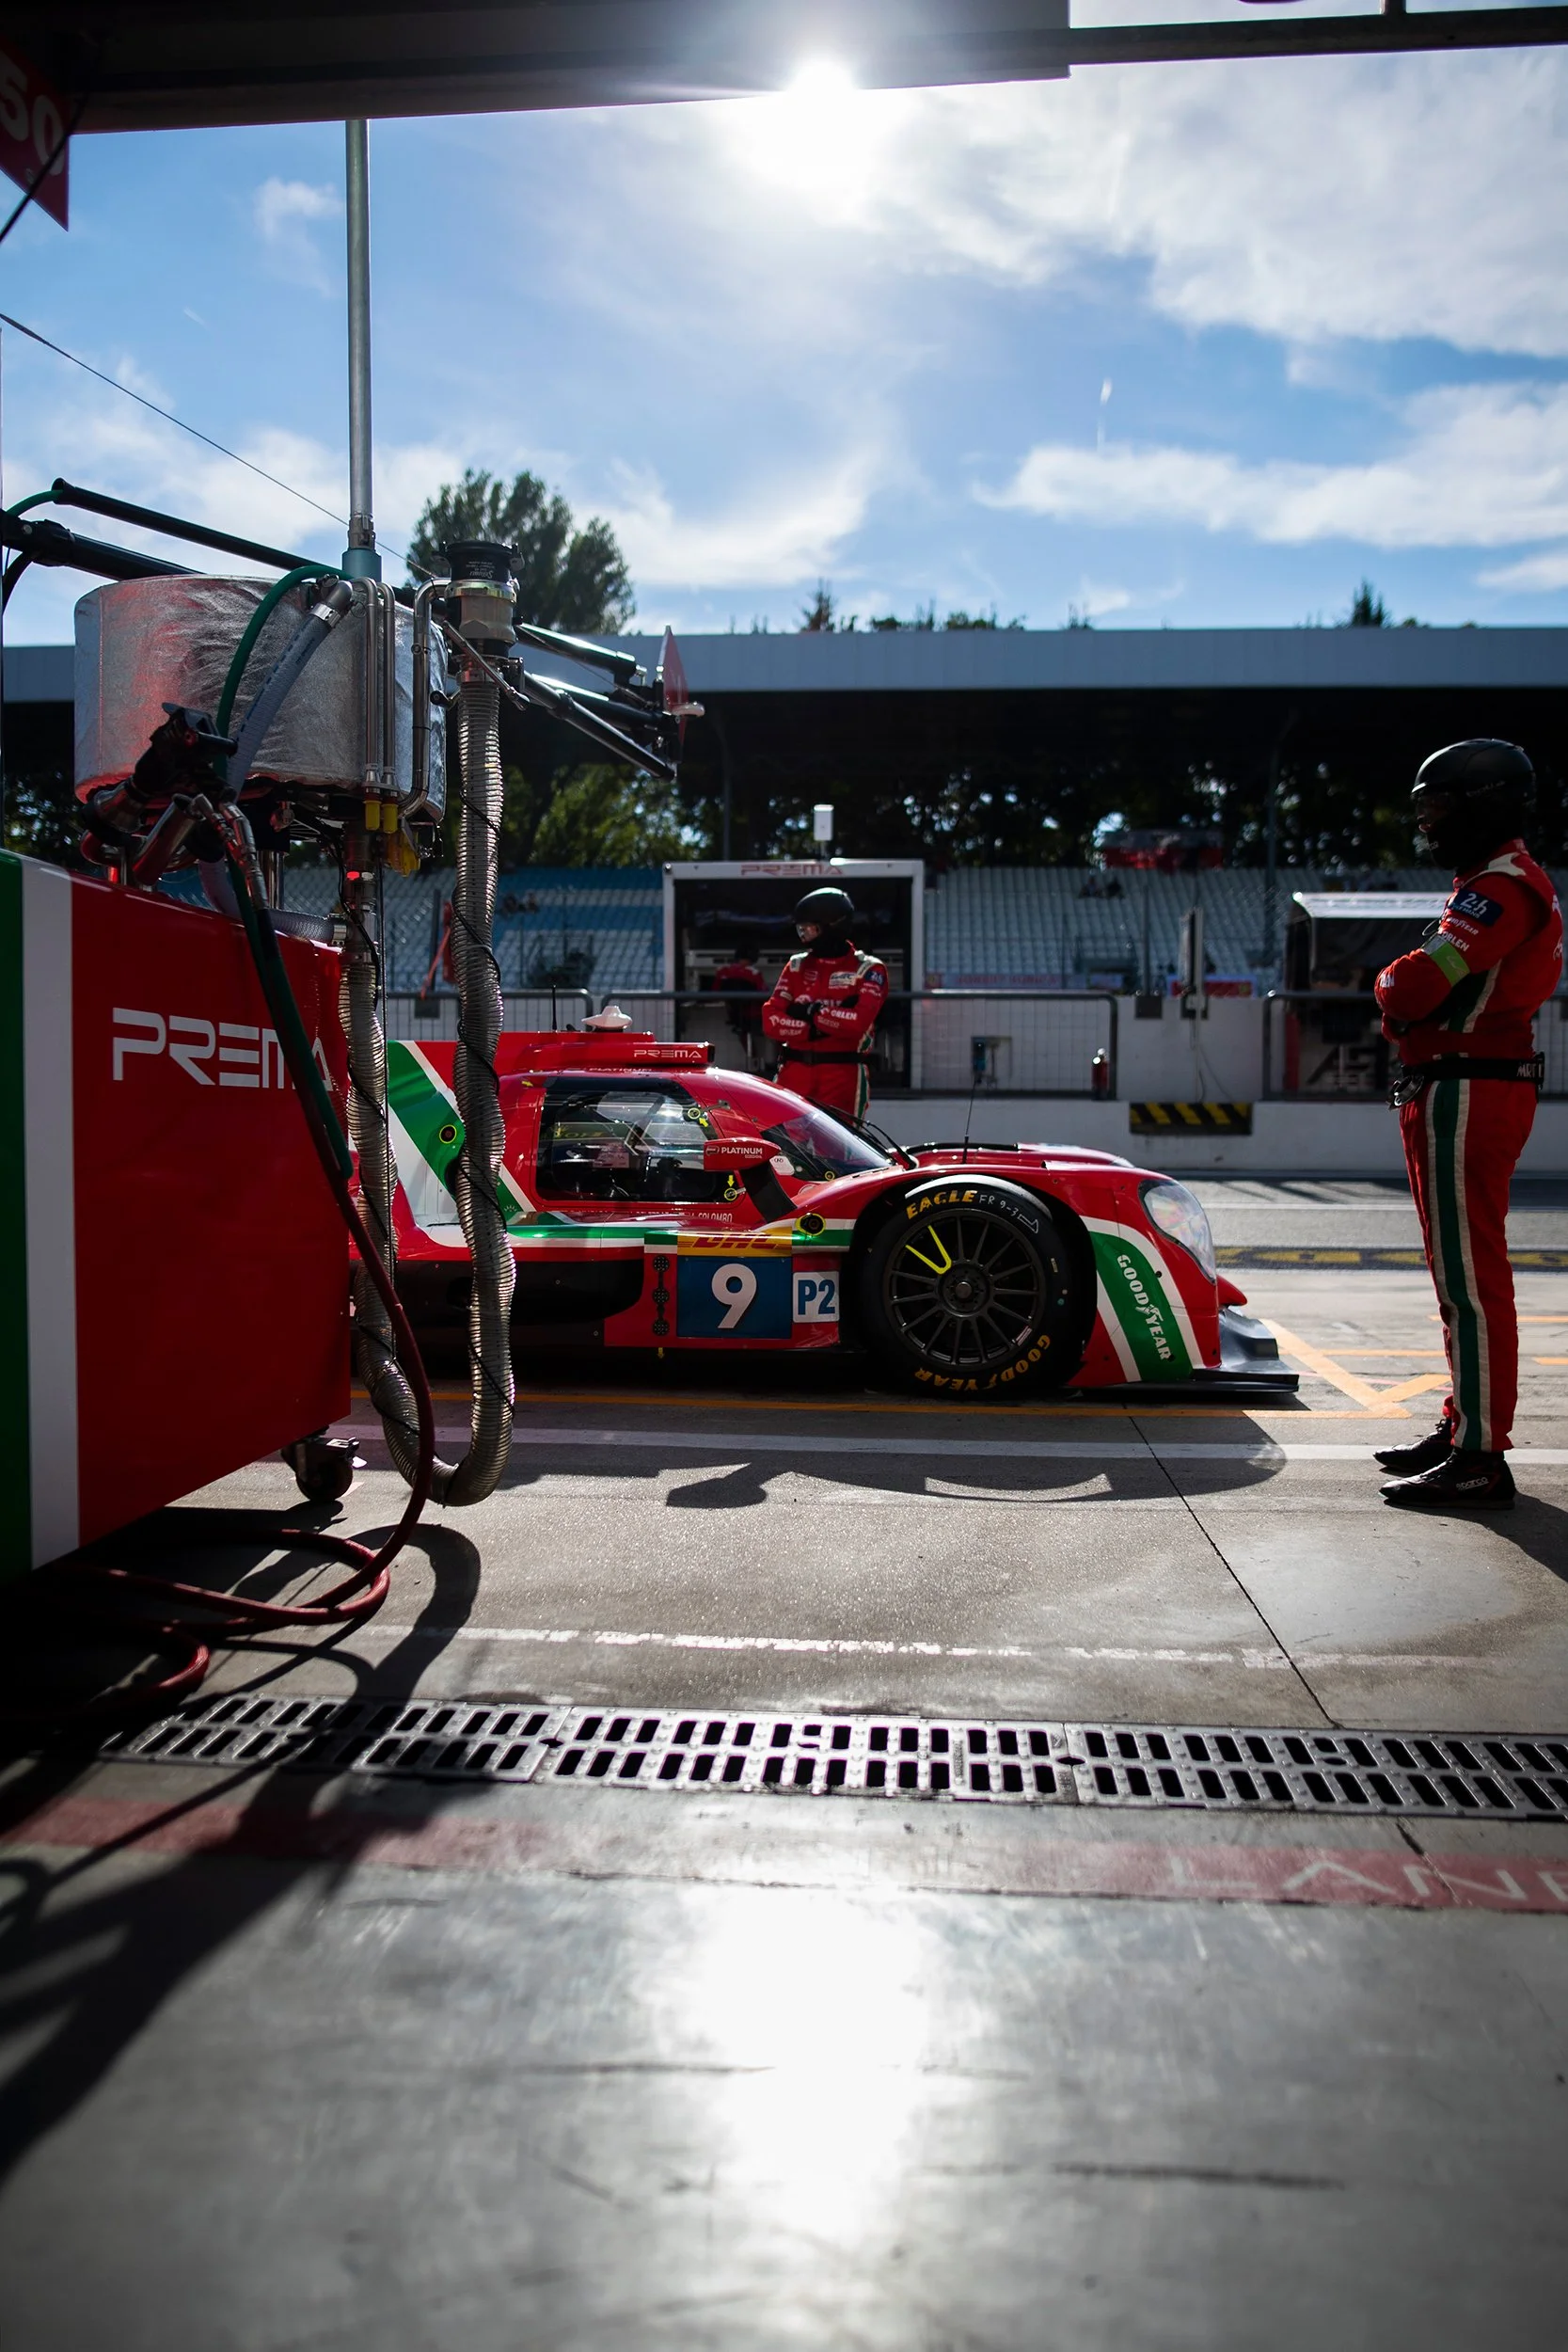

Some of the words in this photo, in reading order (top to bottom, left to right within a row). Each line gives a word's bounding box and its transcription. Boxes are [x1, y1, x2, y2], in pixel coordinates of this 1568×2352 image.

[741, 864, 843, 876] PREMA
[831, 1009, 858, 1021] ORLEN
[634, 1049, 702, 1059] PREMA
[721, 1147, 763, 1155] PLATINUM
[905, 1190, 978, 1220] EAGLE
[979, 1194, 995, 1205] FR
[693, 1233, 779, 1250] DHL
[711, 1263, 757, 1329] 9
[798, 1279, 835, 1315] P2
[1117, 1254, 1172, 1360] GOODYEAR
